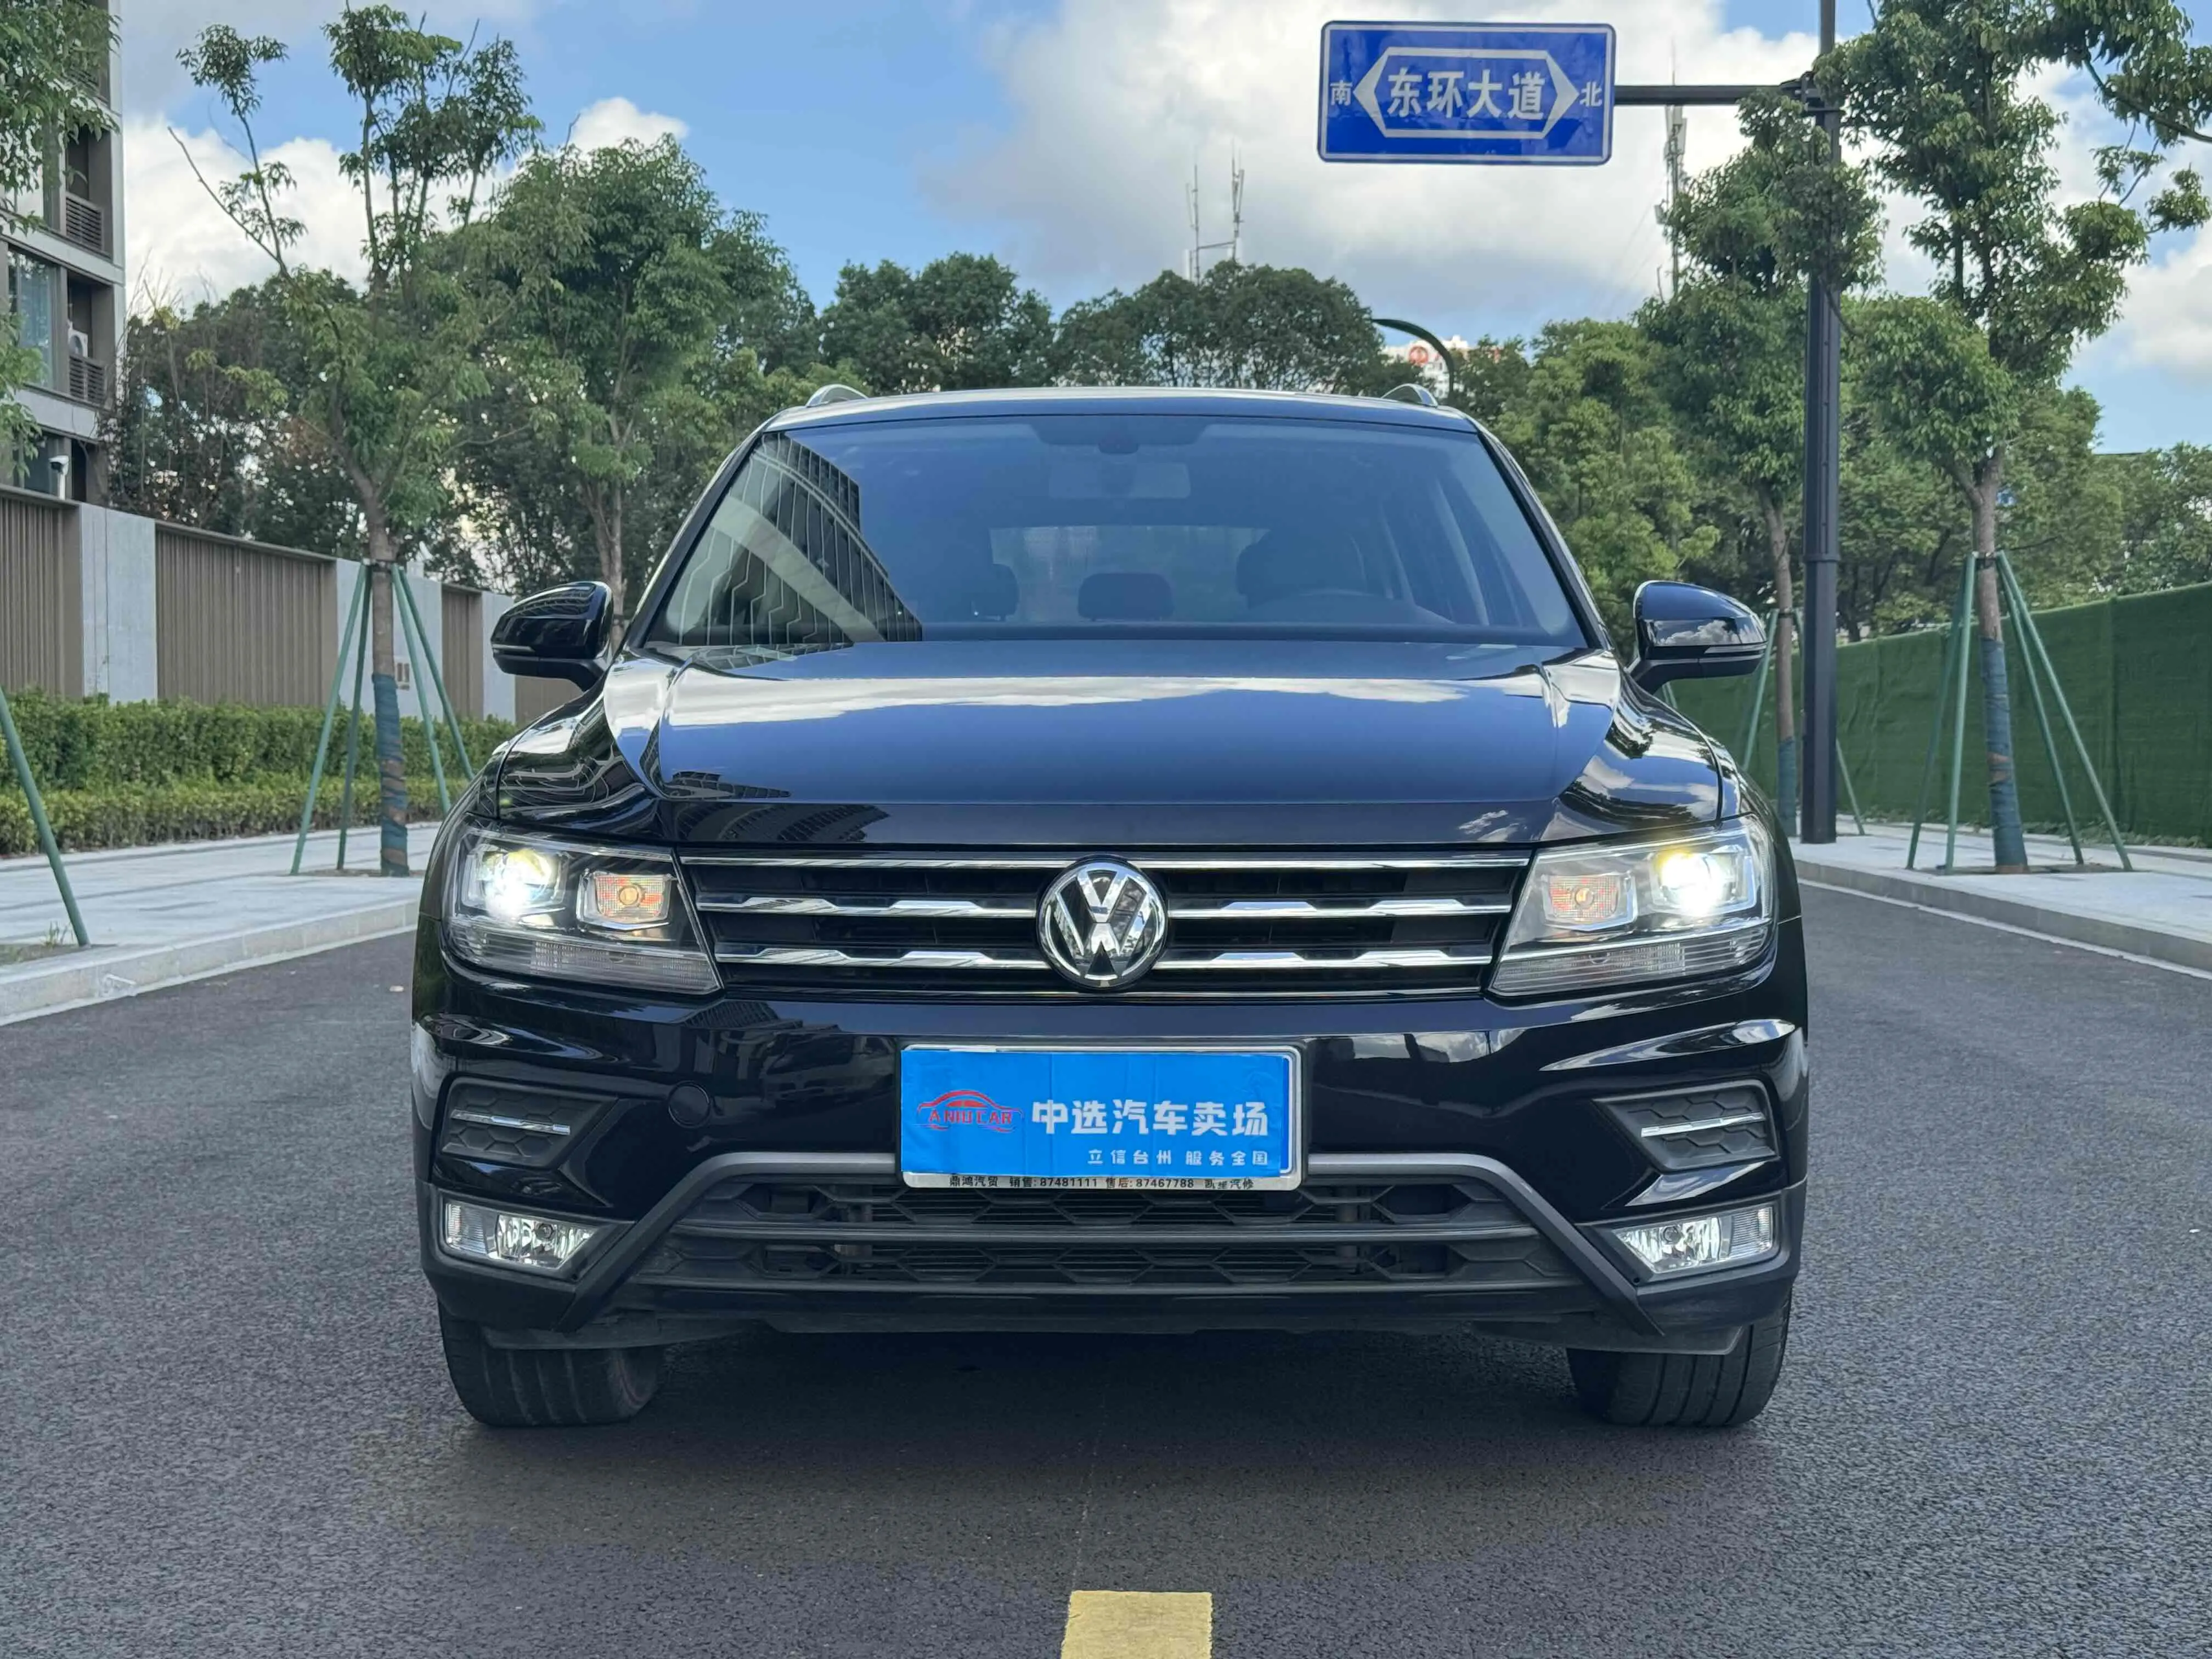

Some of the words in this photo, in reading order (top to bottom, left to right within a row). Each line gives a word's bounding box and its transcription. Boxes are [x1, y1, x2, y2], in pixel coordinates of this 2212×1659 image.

[1330, 81, 1353, 105] 南
[1387, 67, 1546, 120] 东环大道
[1579, 82, 1603, 107] 北
[976, 1110, 1012, 1125] CAR
[1032, 1099, 1268, 1136] 中选汽车卖场
[1087, 1149, 1171, 1165] 立信台州
[1186, 1150, 1268, 1166] 服务全国
